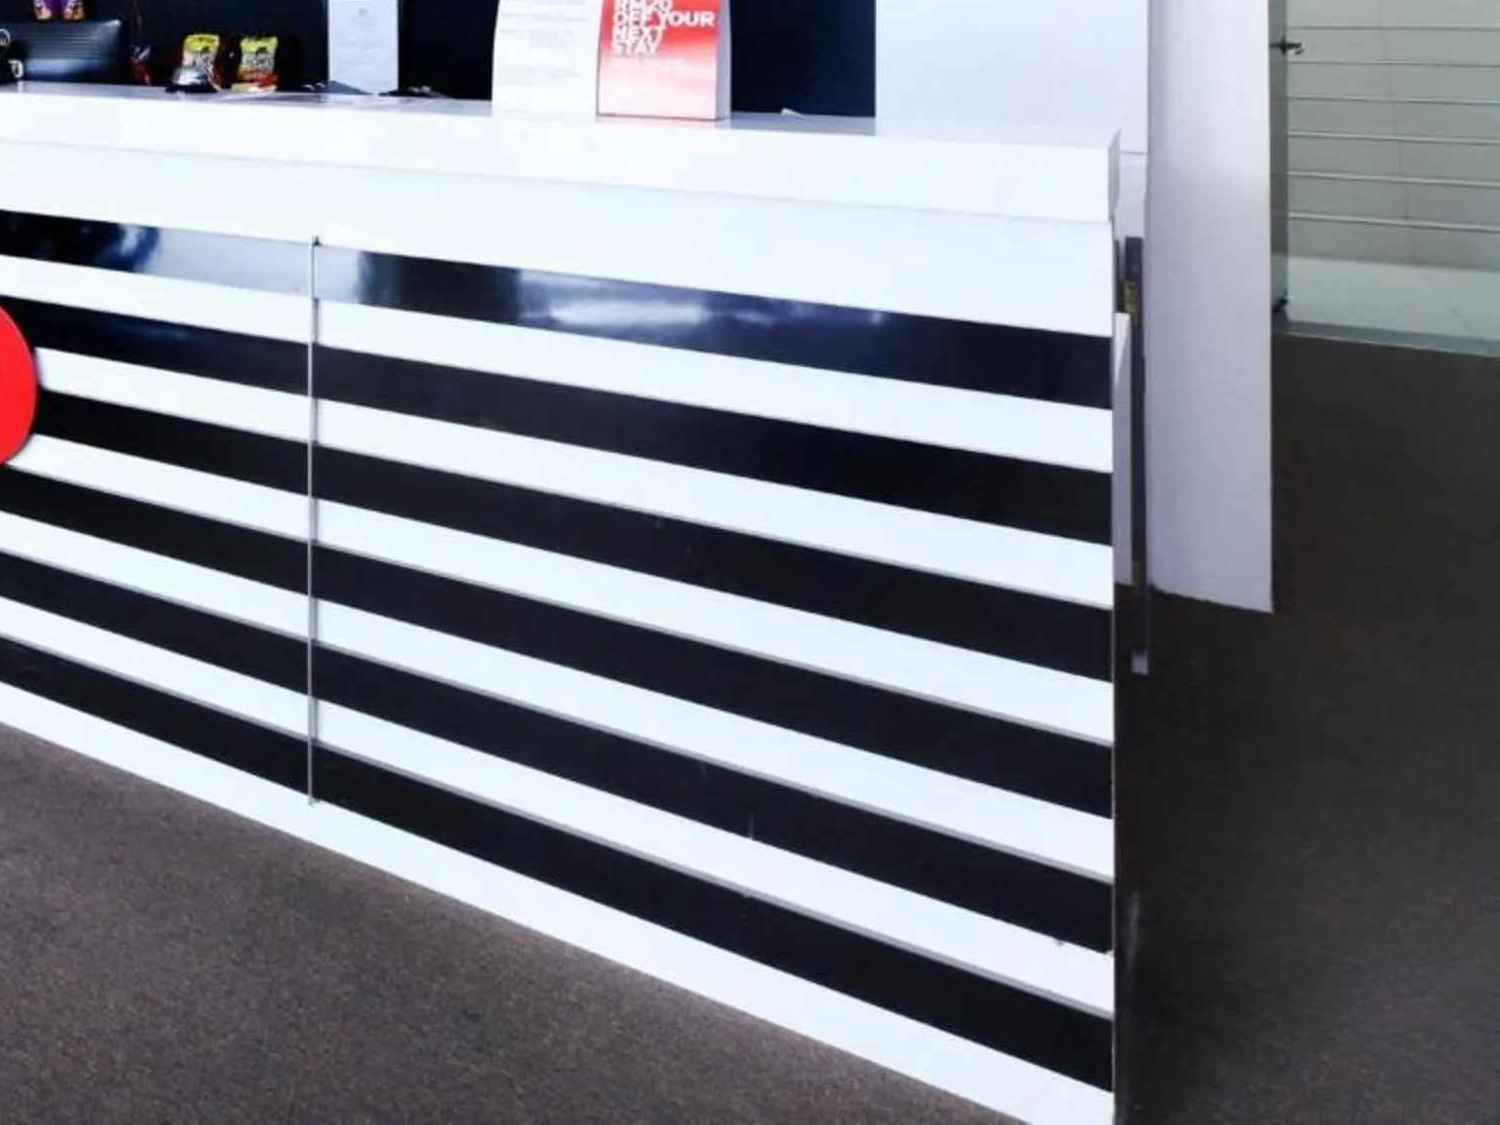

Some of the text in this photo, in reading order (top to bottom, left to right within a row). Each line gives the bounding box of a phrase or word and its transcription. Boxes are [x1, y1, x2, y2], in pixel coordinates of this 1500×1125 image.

[613, 10, 716, 27] OFF YOUR
[612, 26, 666, 41] NEXT
[611, 40, 660, 55] STAY
